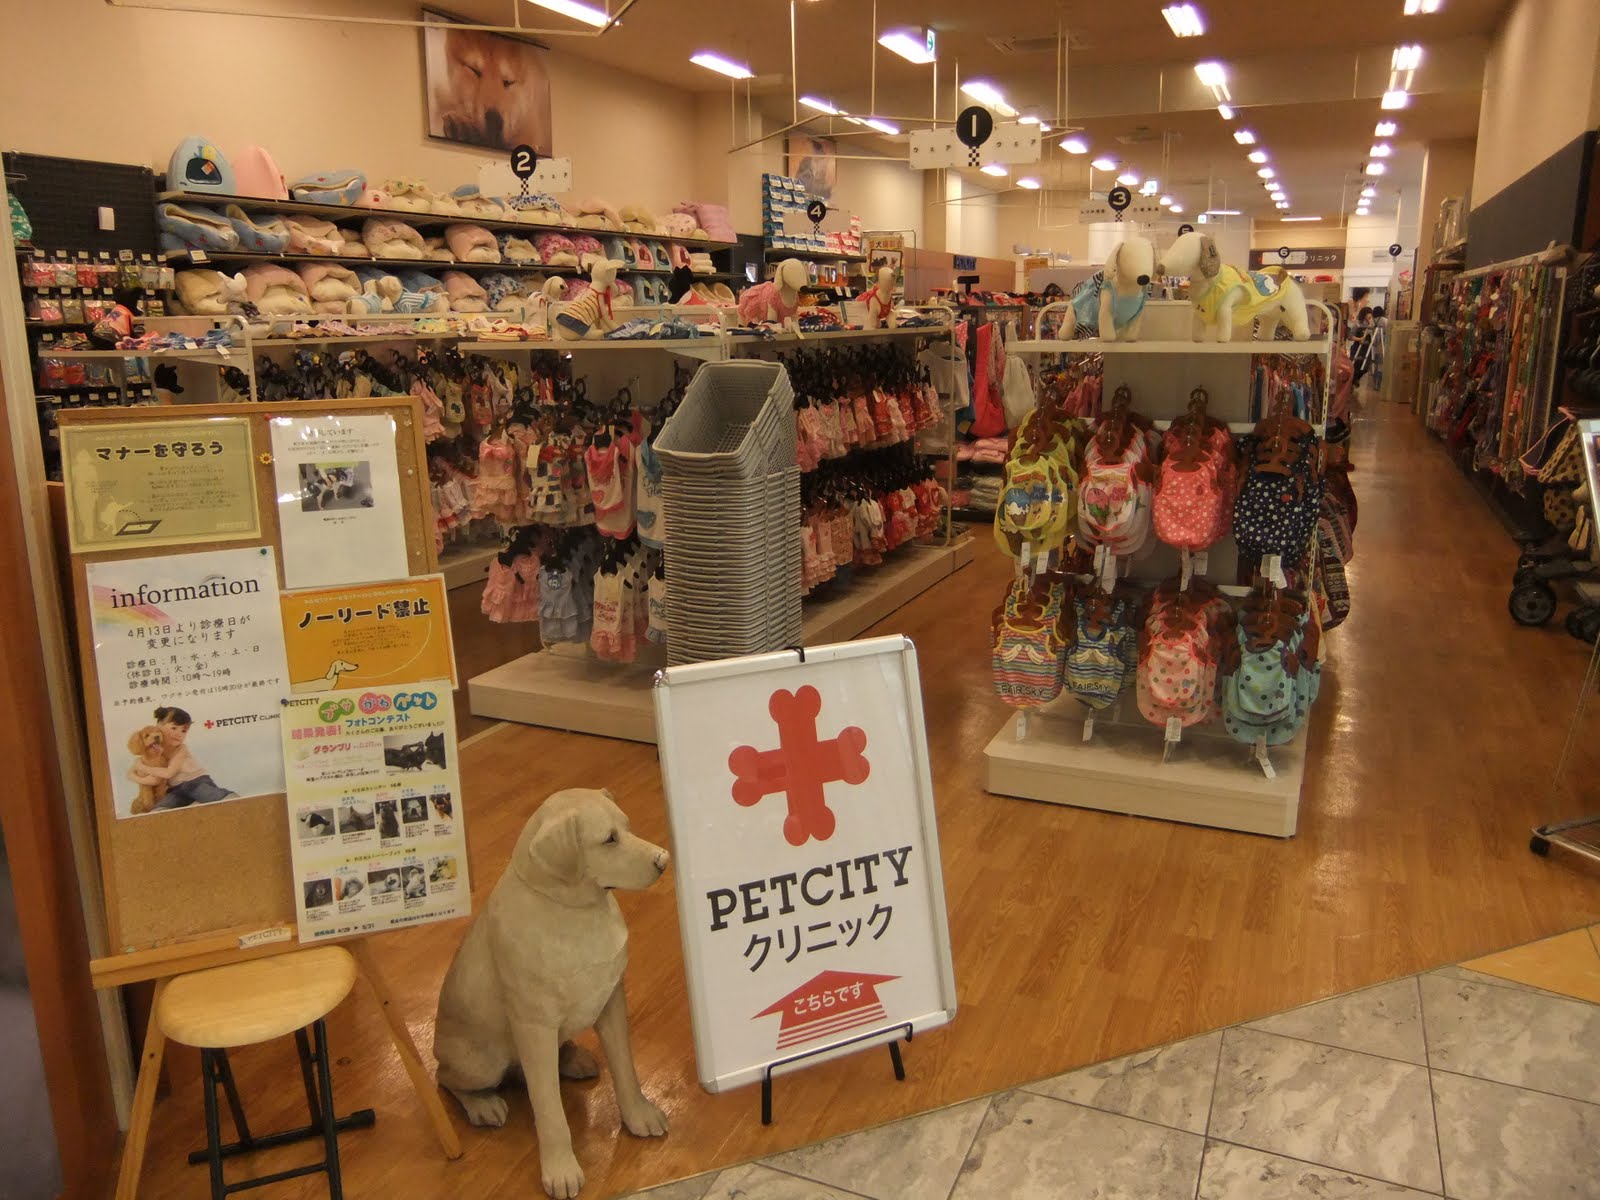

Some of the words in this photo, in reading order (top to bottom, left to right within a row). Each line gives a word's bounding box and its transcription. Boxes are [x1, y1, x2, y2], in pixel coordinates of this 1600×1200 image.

[516, 151, 531, 172] 2
[1112, 191, 1127, 206] 3
[810, 204, 822, 218] 4
[1281, 248, 1288, 256] 6
[1391, 246, 1399, 254] 7
[96, 441, 224, 461] マナーを守ろう
[111, 576, 261, 609] information
[299, 597, 431, 630] ノーリード禁止
[127, 614, 251, 639] 4月13日より診療日が
[146, 628, 237, 650] 変更になります
[216, 714, 258, 728] PETCITY
[345, 713, 411, 728] フォトコンテスト
[313, 742, 351, 754] グランプリ
[706, 845, 913, 932] PETCITY
[743, 903, 893, 973] クリニック
[793, 981, 864, 1015] こちらです
